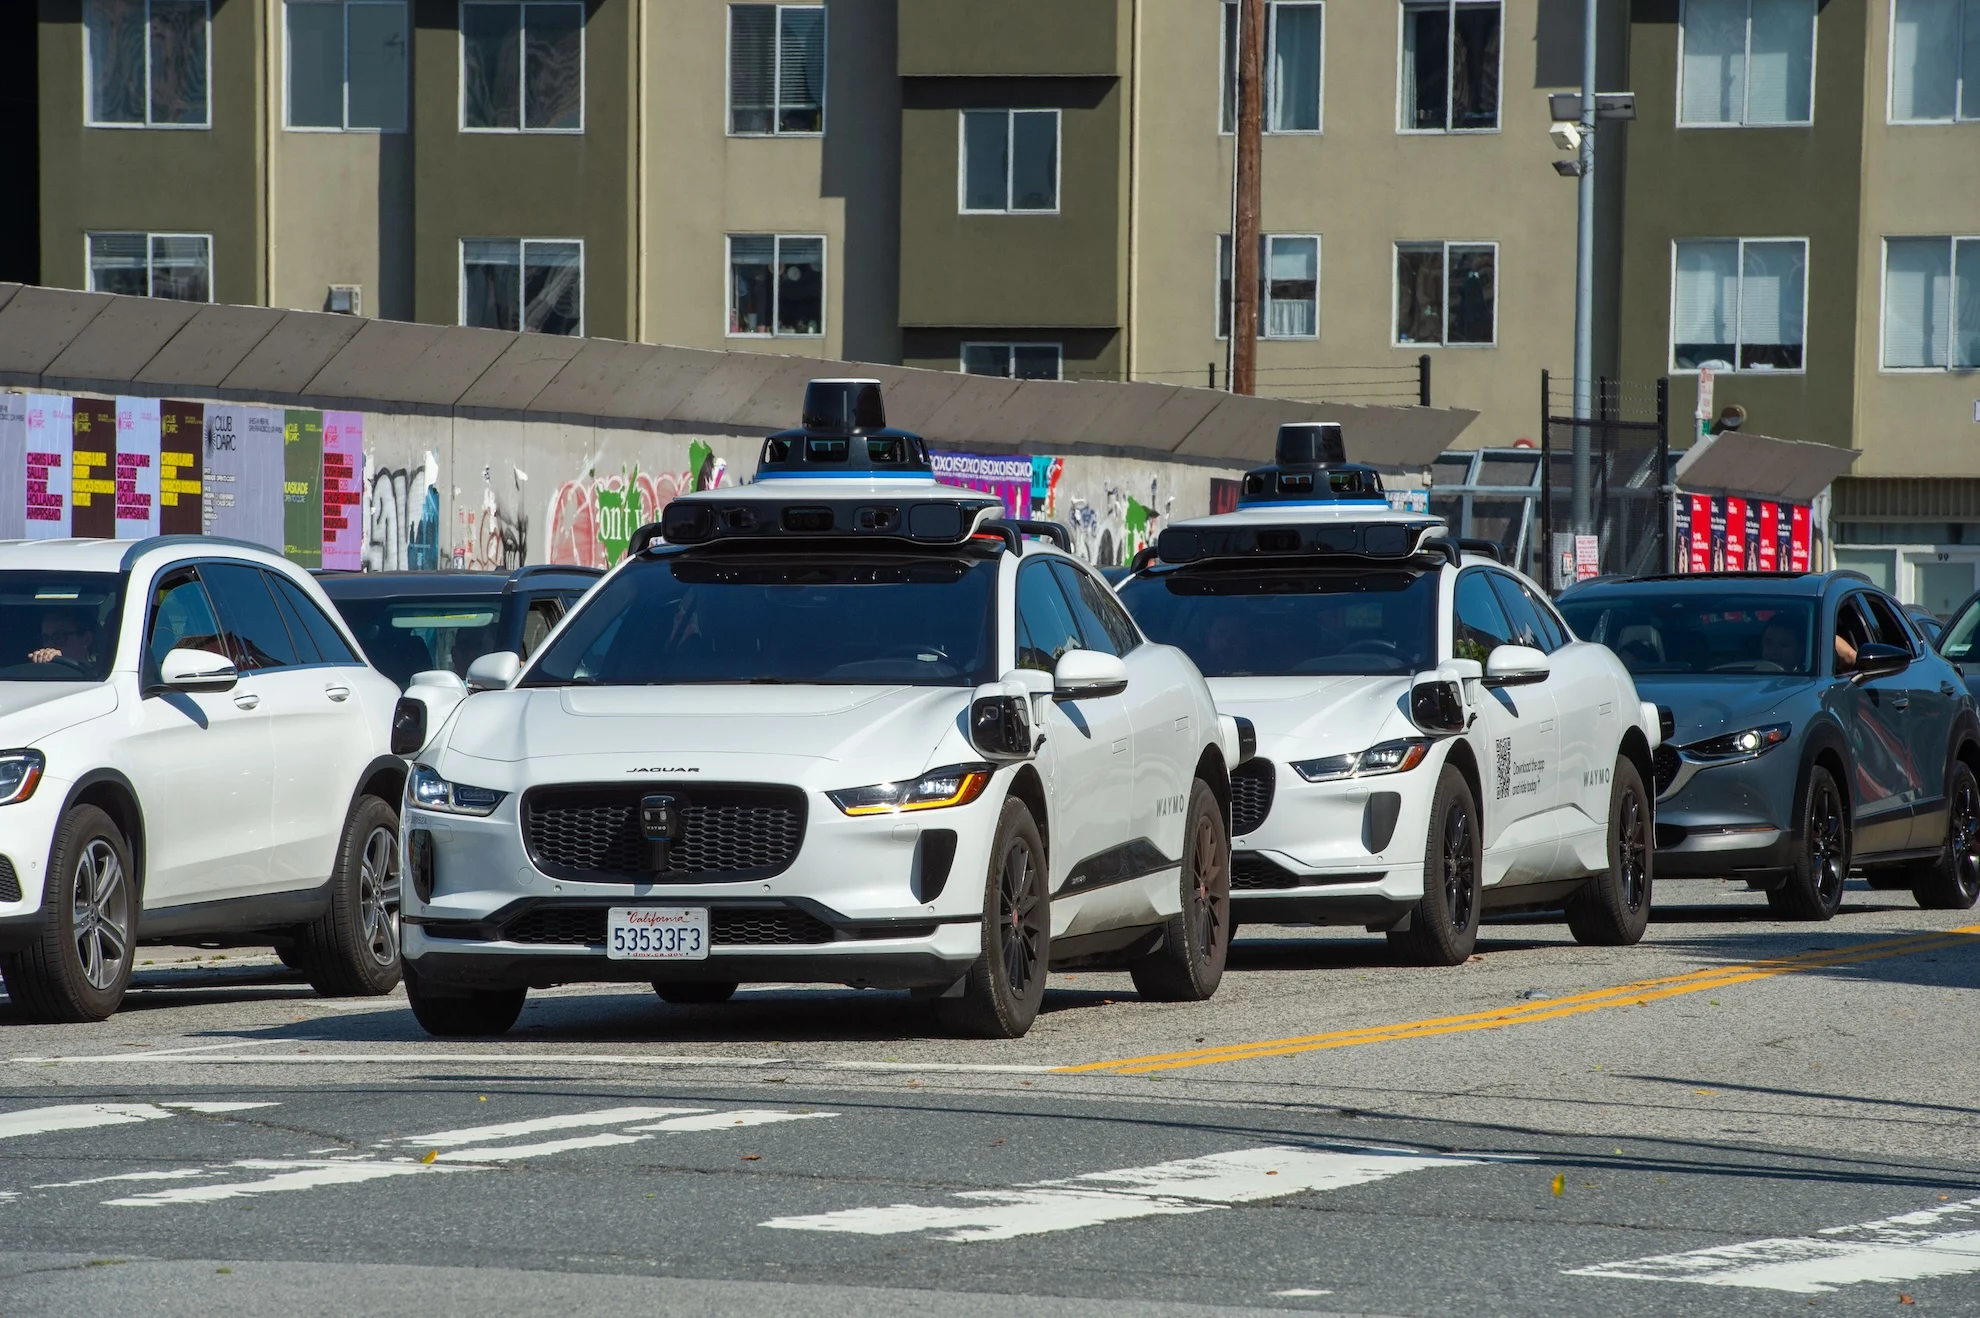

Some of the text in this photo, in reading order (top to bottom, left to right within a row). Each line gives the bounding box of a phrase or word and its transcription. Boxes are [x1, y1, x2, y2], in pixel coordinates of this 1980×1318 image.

[214, 416, 232, 432] CLUB
[216, 434, 236, 450] DARC
[27, 452, 61, 467] CHRIS LAKE
[118, 453, 150, 467] CHRIS LAKE
[953, 456, 980, 474] ISOXO
[980, 459, 1005, 476] ISOXO
[1005, 460, 1032, 477] ISOXO
[27, 466, 48, 480] SALUTE
[118, 466, 137, 480] SALUTE
[284, 482, 308, 494] KASKADE
[27, 493, 63, 507] HOLLANDER
[117, 493, 151, 506] HOLLANDER
[1938, 553, 1949, 561] 99
[1513, 760, 1531, 775] Download
[1537, 760, 1545, 772] app
[1584, 768, 1610, 787] WAYMO
[1512, 784, 1520, 795] and
[1526, 780, 1537, 794] today
[1157, 794, 1185, 817] WAYMO
[629, 912, 690, 927] California
[615, 928, 700, 951] 53533F3
